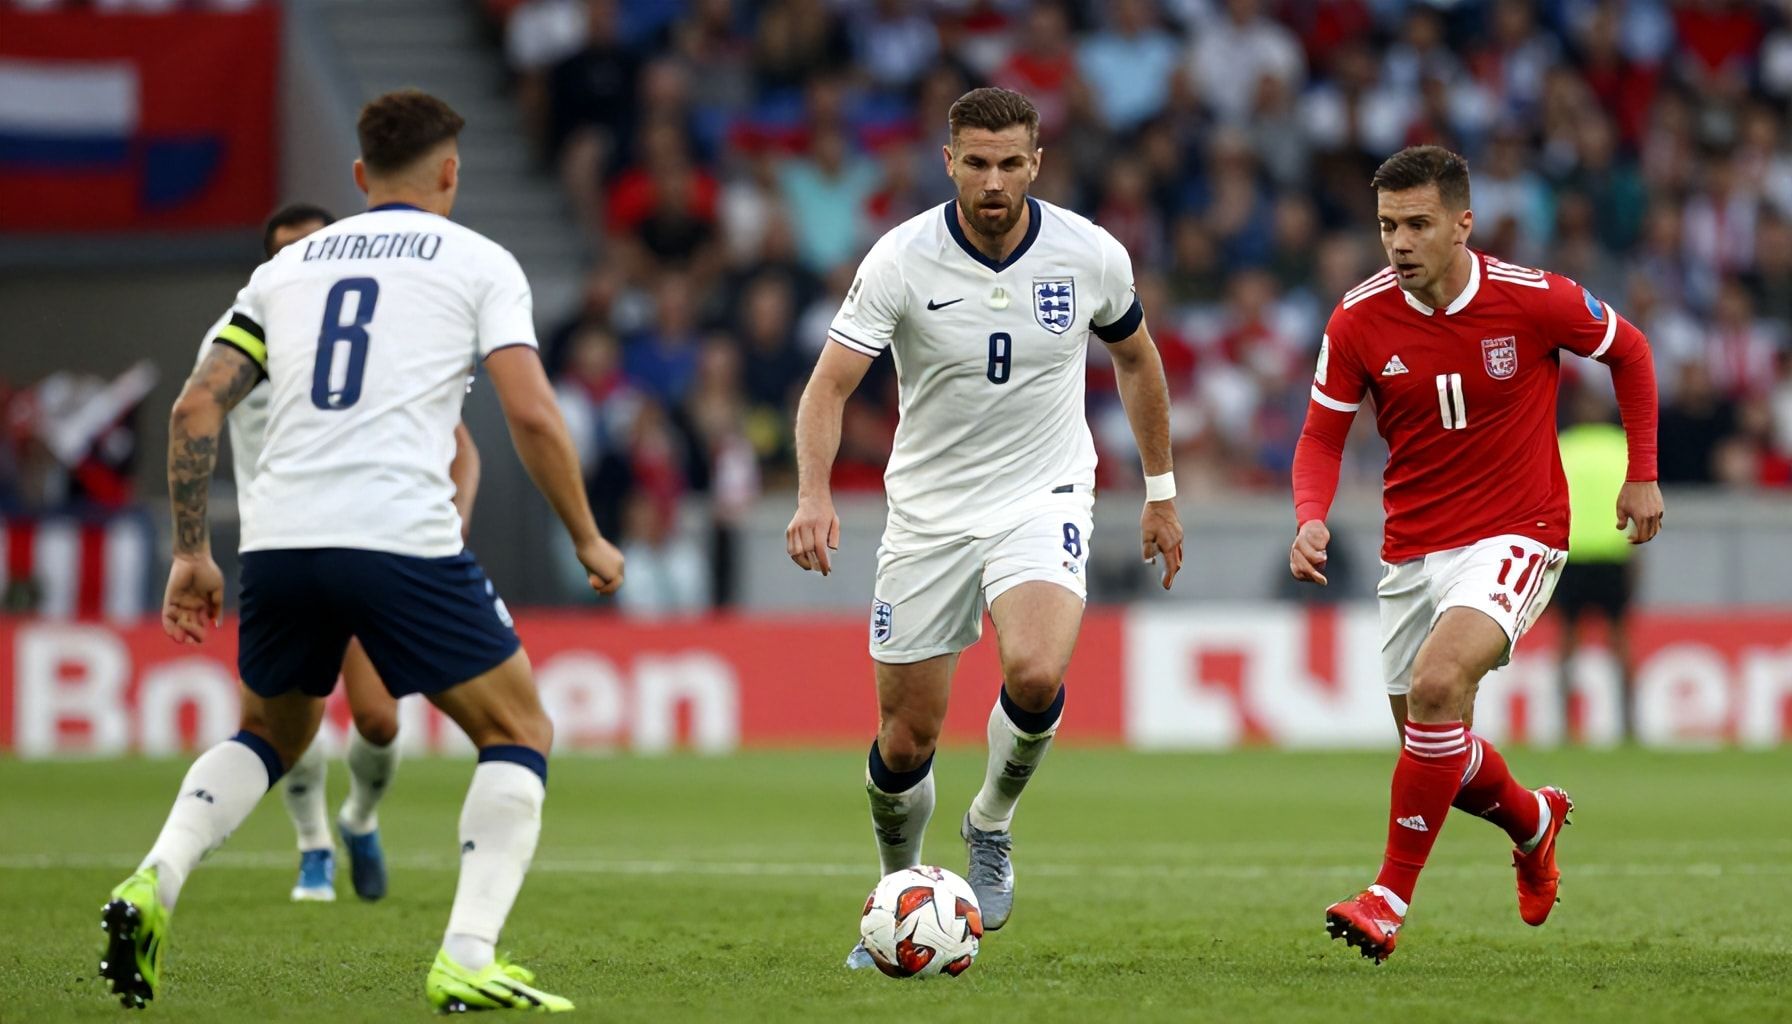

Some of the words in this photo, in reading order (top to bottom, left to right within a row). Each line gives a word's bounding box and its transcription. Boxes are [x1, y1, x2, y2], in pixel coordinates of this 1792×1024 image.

[311, 277, 379, 411] 8
[987, 332, 1012, 385] 8
[1436, 373, 1467, 429] 11
[1062, 522, 1082, 559] 8
